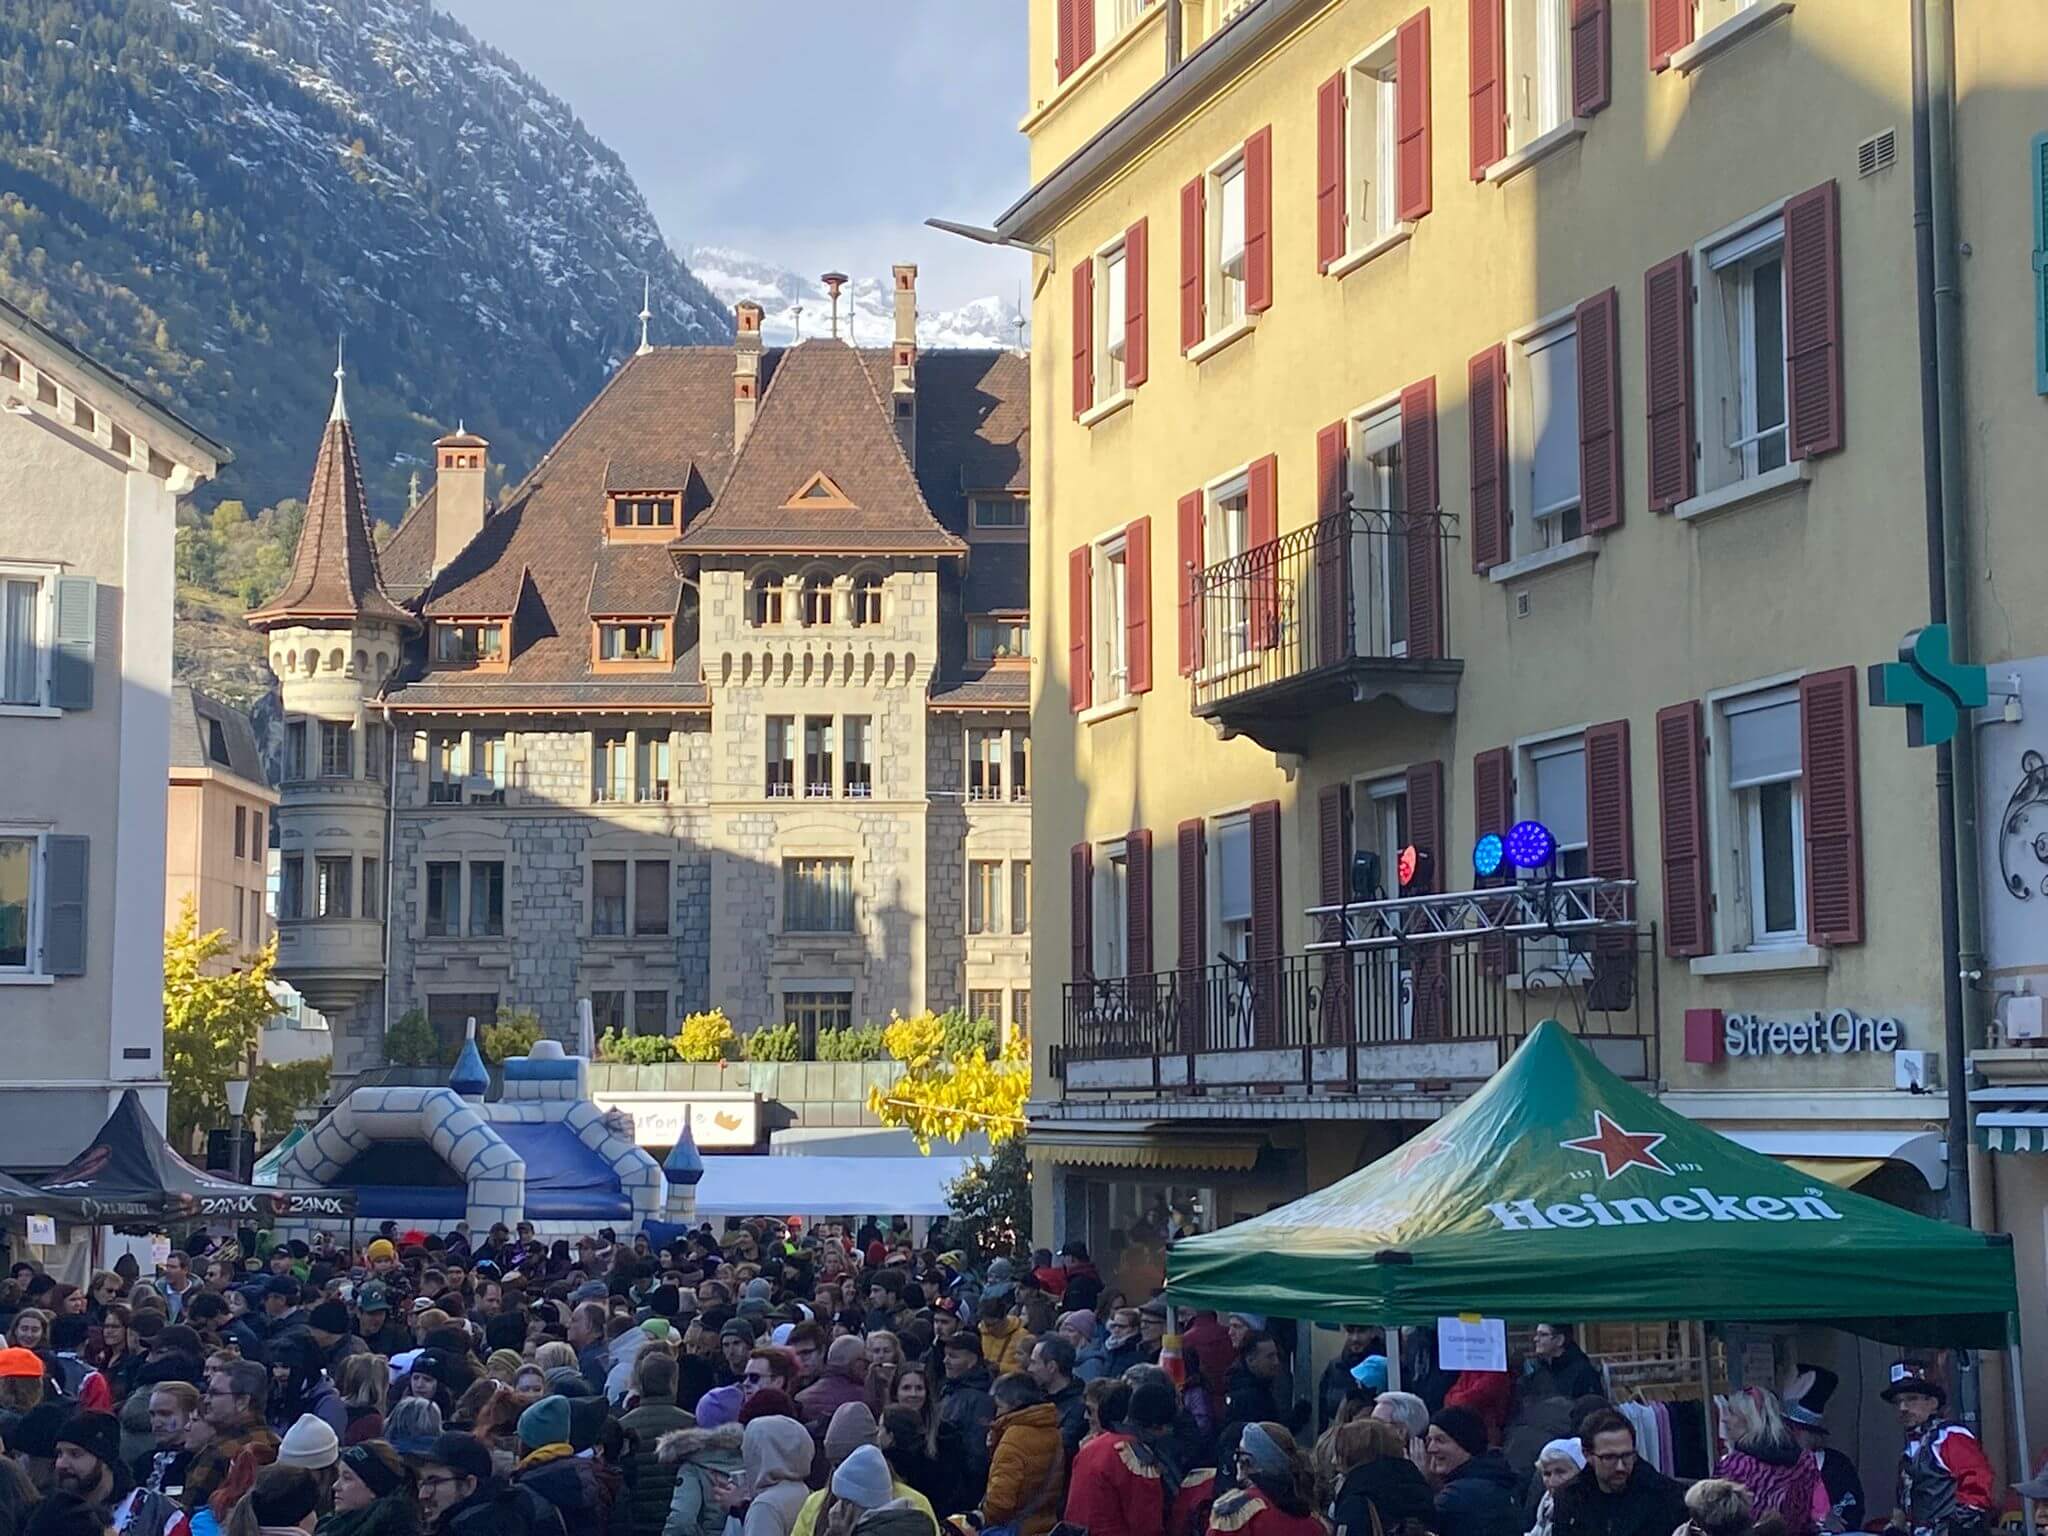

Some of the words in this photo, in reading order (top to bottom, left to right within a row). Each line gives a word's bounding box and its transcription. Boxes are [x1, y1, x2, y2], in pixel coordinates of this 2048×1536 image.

[200, 1195, 257, 1215] 24MX
[289, 1196, 344, 1214] 24MX
[1485, 1188, 1844, 1231] Heineken
